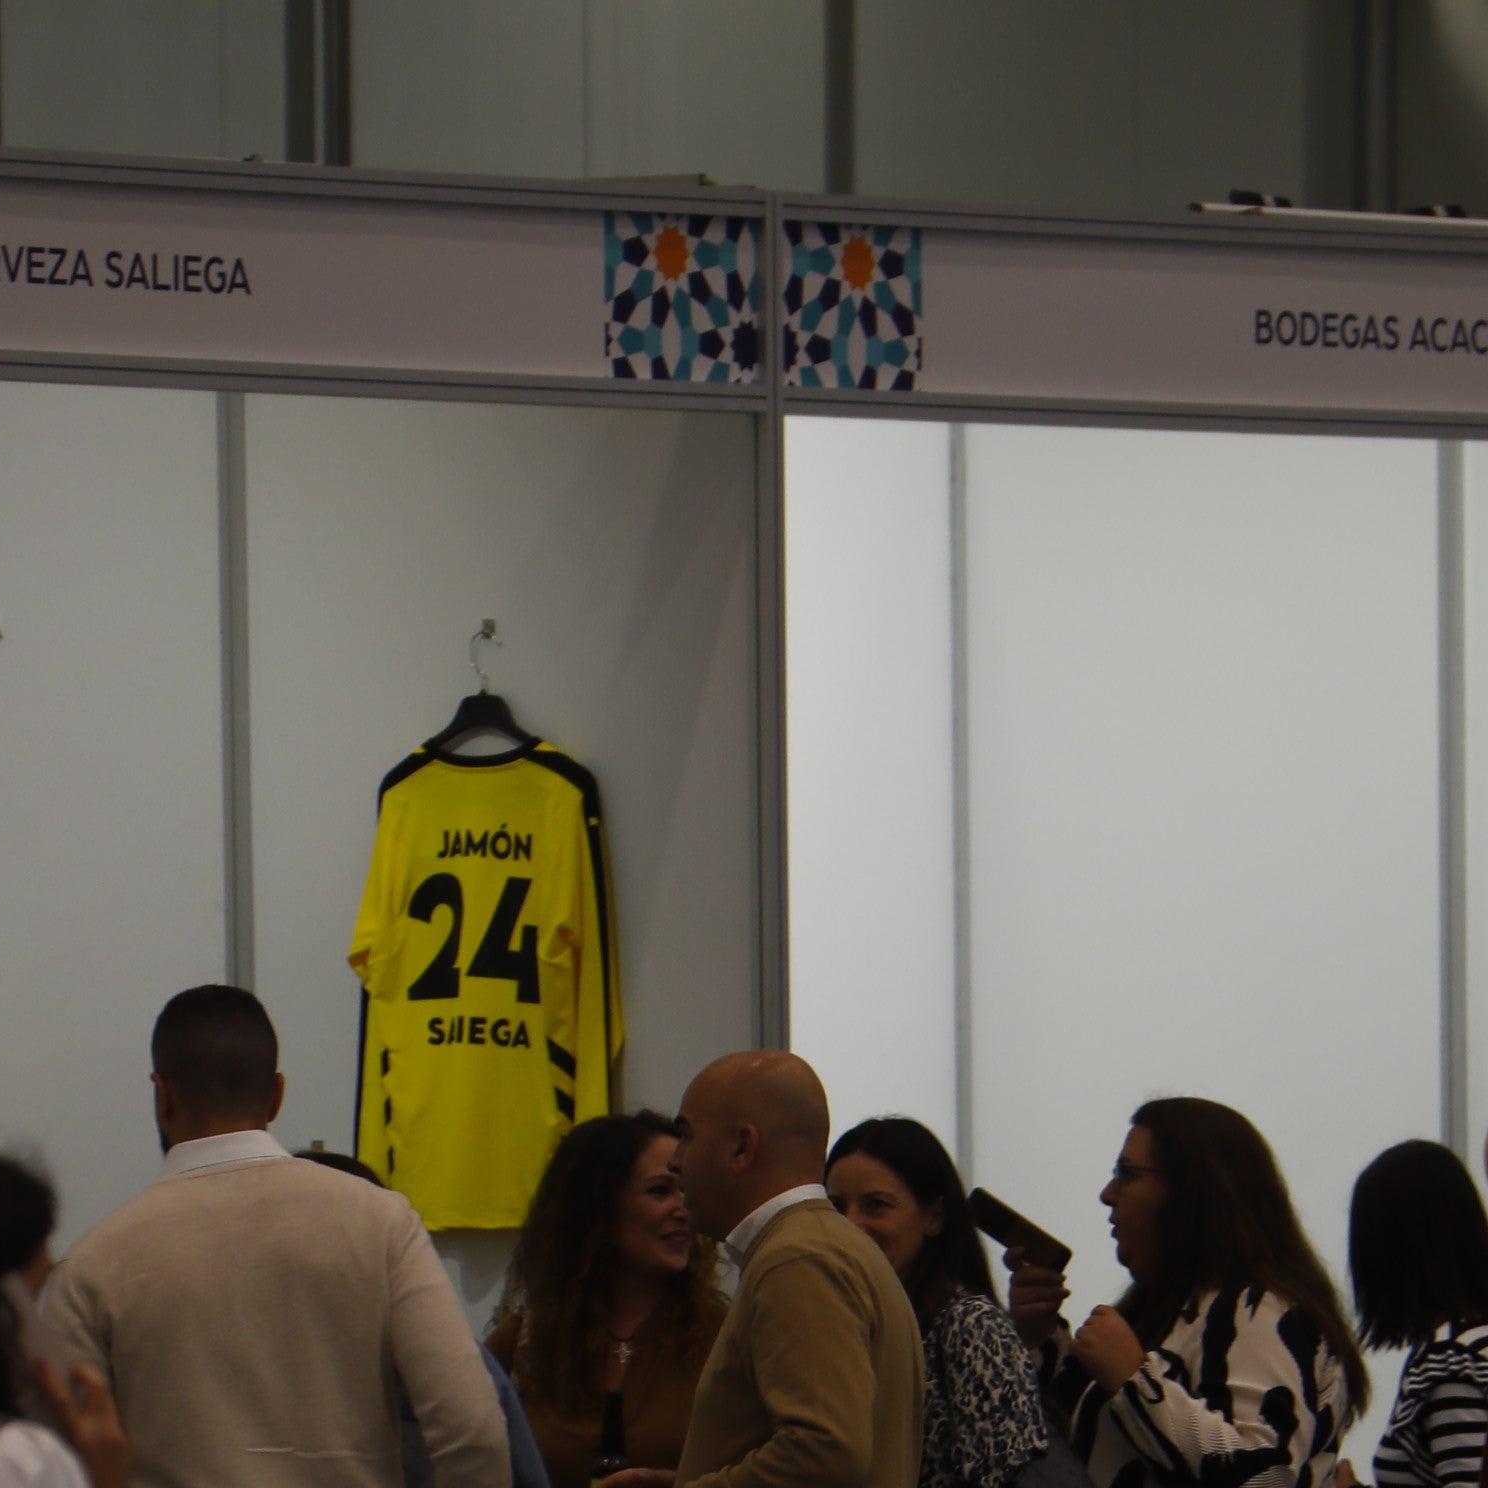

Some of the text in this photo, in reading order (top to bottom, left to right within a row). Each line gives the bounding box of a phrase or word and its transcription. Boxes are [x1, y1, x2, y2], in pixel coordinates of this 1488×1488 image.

[104, 250, 252, 295] SALIEGA
[1254, 309, 1400, 350] BODEGAS
[437, 823, 533, 862] JAMÓN
[407, 872, 542, 1005] 24
